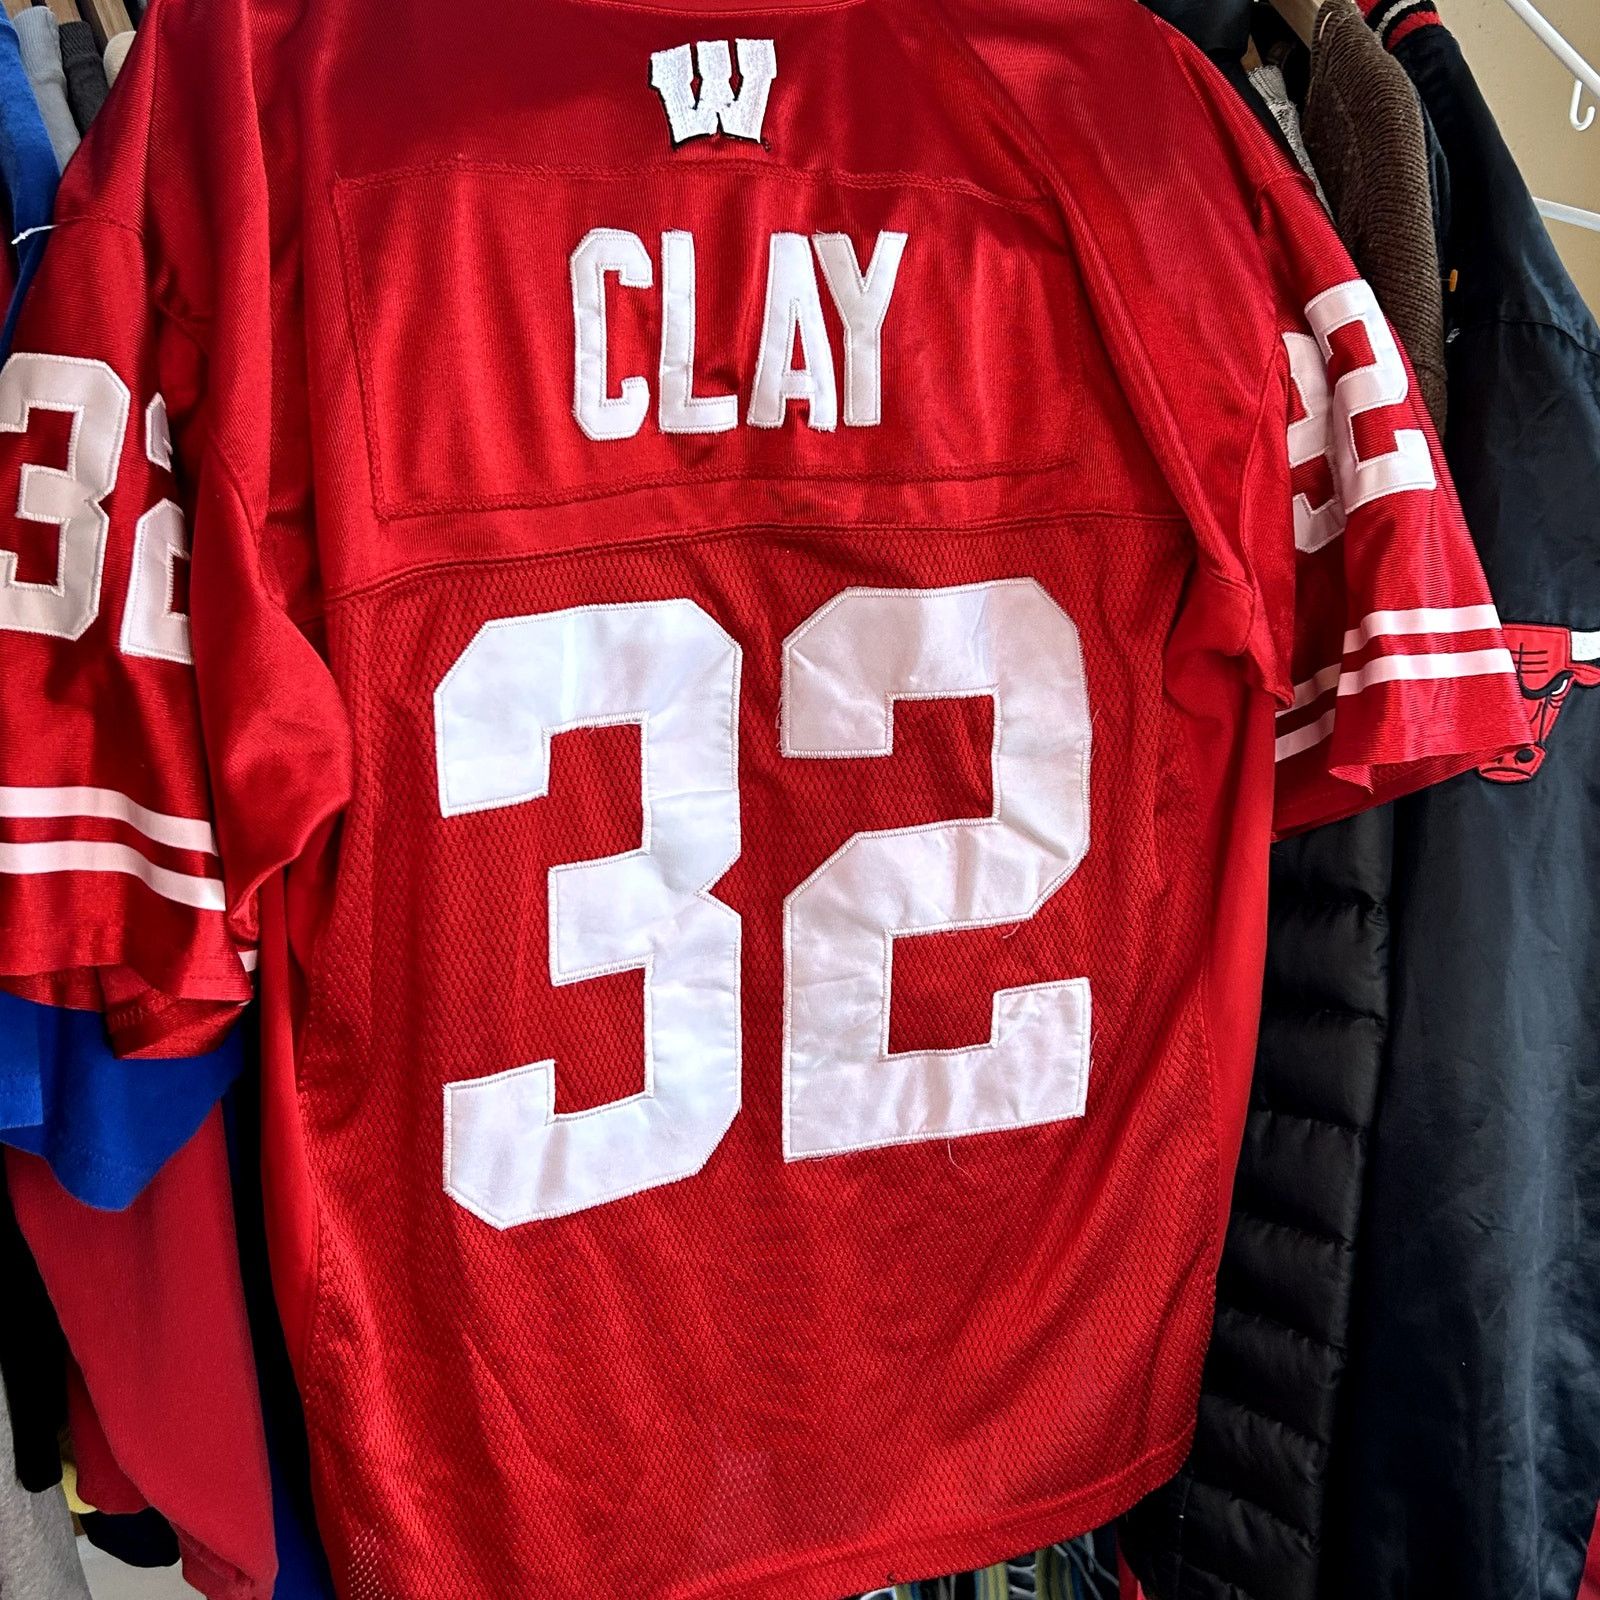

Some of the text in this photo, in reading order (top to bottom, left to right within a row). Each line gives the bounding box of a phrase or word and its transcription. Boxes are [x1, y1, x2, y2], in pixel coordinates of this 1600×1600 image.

[650, 38, 777, 147] W
[569, 227, 908, 442] CLAY
[433, 576, 1093, 1230] 32
